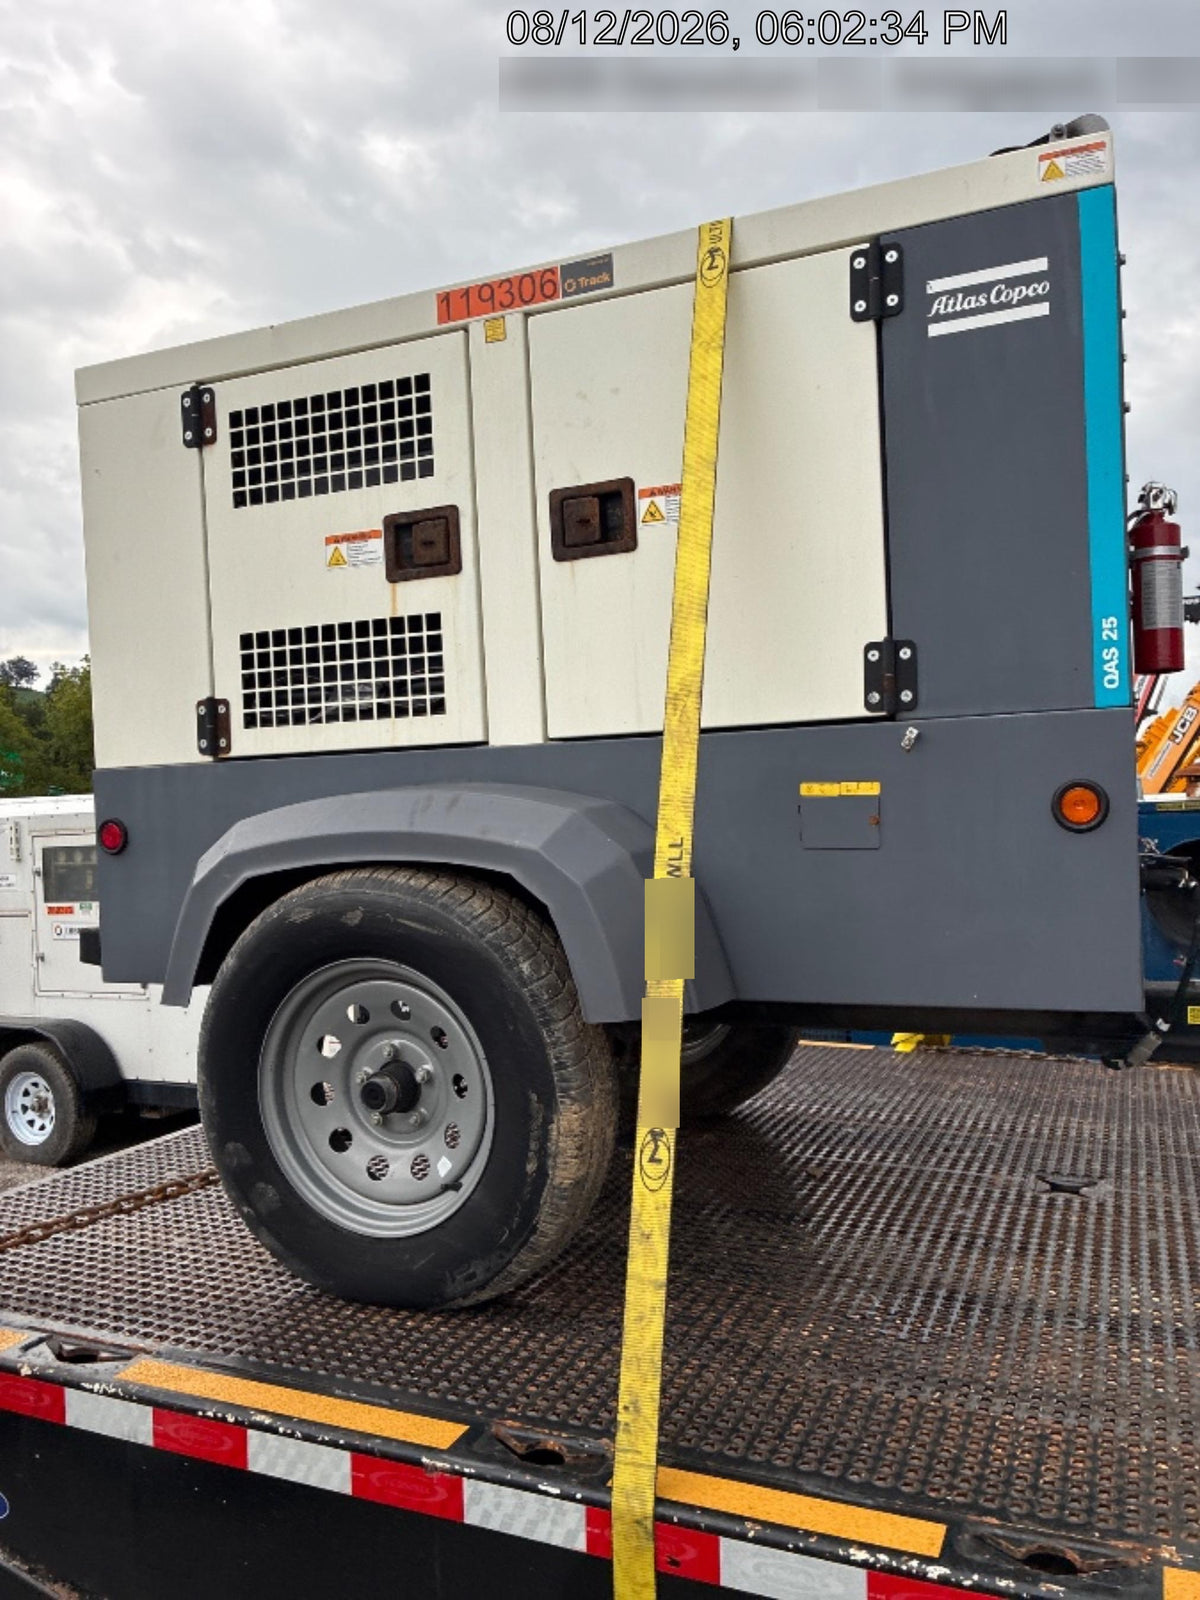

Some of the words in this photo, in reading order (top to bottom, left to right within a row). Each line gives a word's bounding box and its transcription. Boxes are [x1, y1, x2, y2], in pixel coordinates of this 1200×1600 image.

[440, 268, 557, 320] 119306
[577, 272, 611, 288] Track
[926, 293, 988, 317] Atlas
[990, 280, 1050, 305] Copco
[1102, 616, 1119, 641] 25
[1102, 646, 1120, 689] QAS
[1173, 706, 1198, 744] JCB
